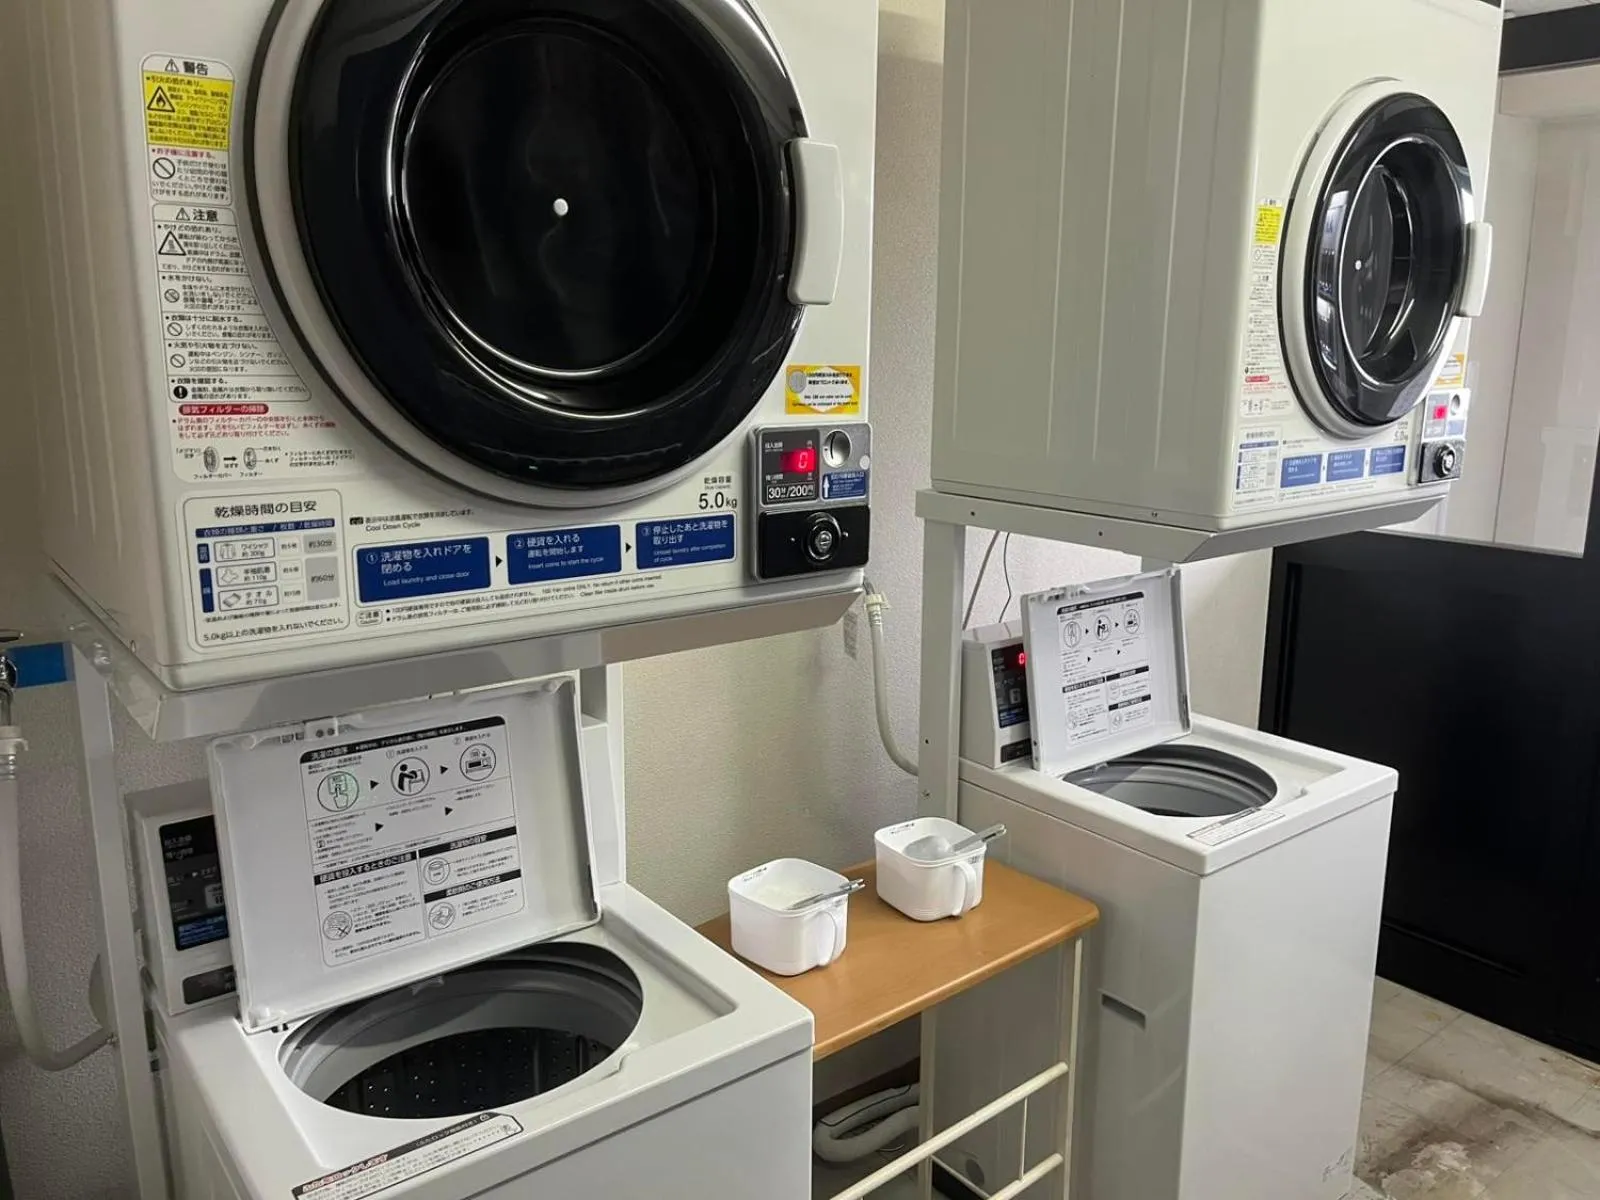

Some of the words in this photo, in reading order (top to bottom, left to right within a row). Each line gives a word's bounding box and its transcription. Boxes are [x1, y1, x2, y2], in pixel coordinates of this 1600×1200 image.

[183, 61, 209, 76] 警告
[193, 209, 219, 222] 注意
[214, 500, 317, 518] 乾燥時間の目安
[653, 520, 728, 533] 停止したあと洗濯物を
[527, 533, 580, 547] 硬貨を入れる
[653, 534, 684, 545] 取り出す
[381, 544, 472, 562] 洗濯物を入れドアを
[381, 562, 413, 575] 閉める
